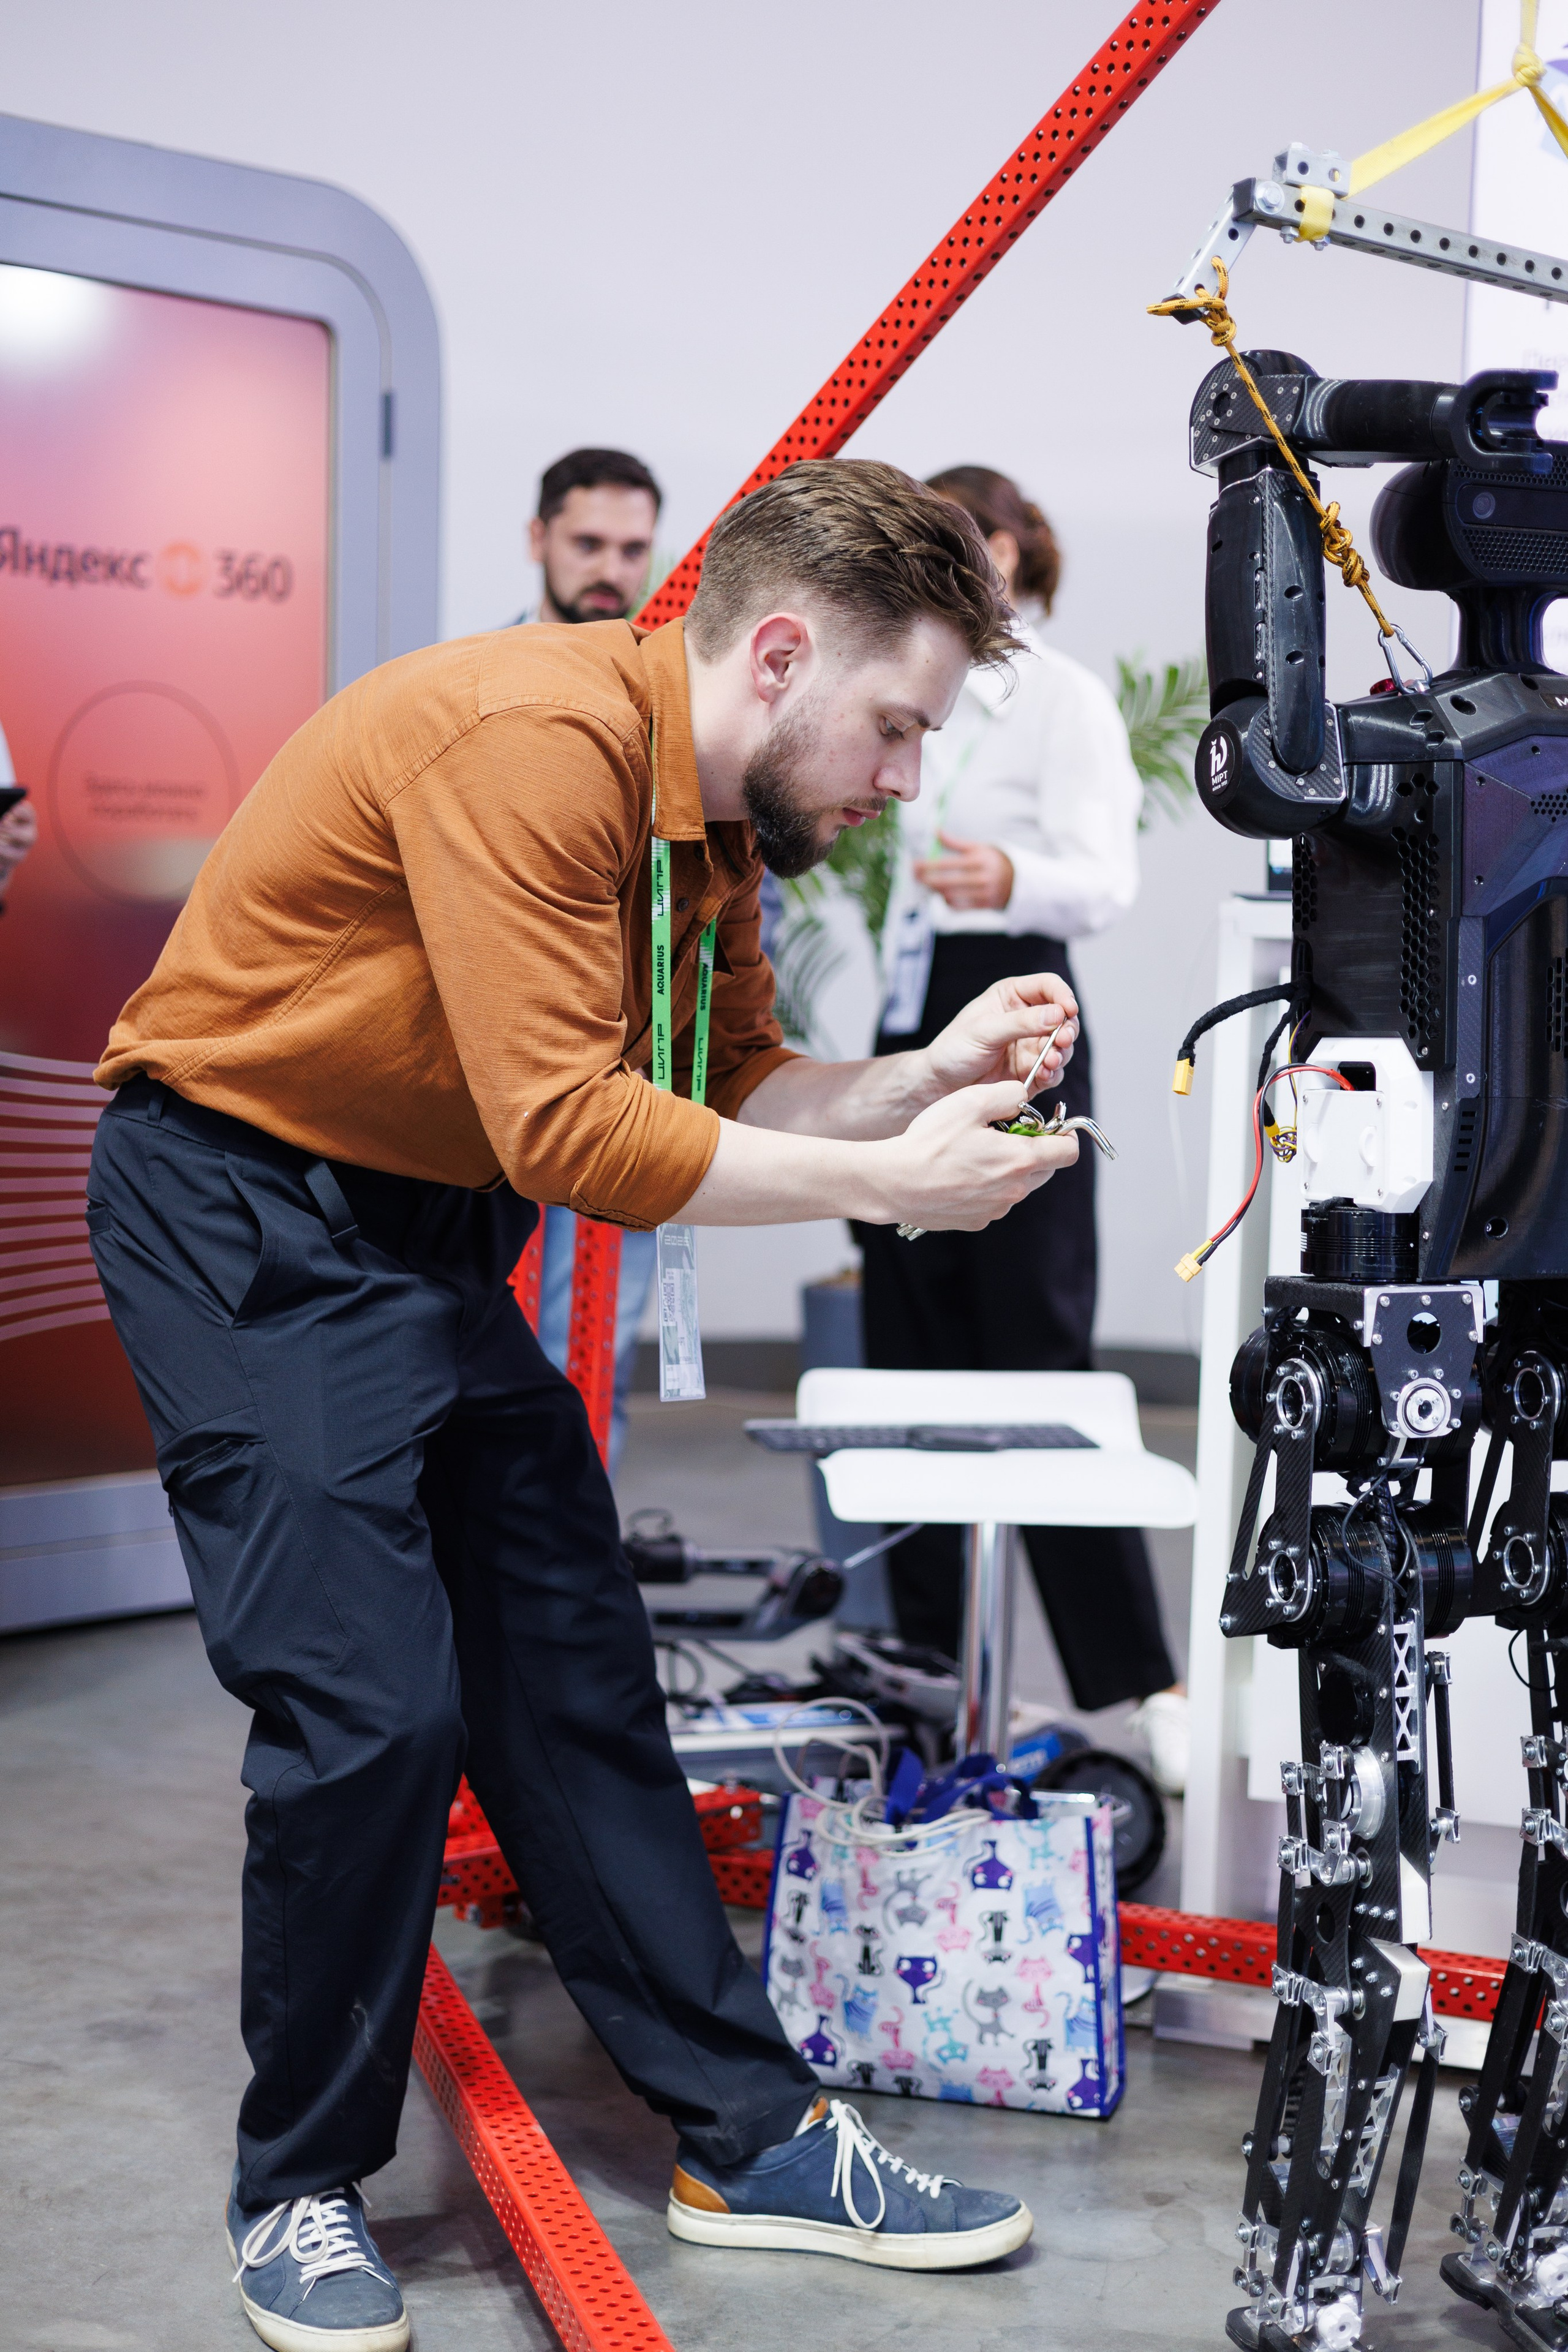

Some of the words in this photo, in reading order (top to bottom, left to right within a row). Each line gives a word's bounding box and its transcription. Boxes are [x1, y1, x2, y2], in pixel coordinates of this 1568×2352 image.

[0, 525, 151, 589] Яндекс
[214, 547, 295, 604] 360
[1212, 770, 1228, 786] MIPT
[656, 944, 665, 995] AQUARIUS
[699, 962, 709, 1011] AQUARIUS
